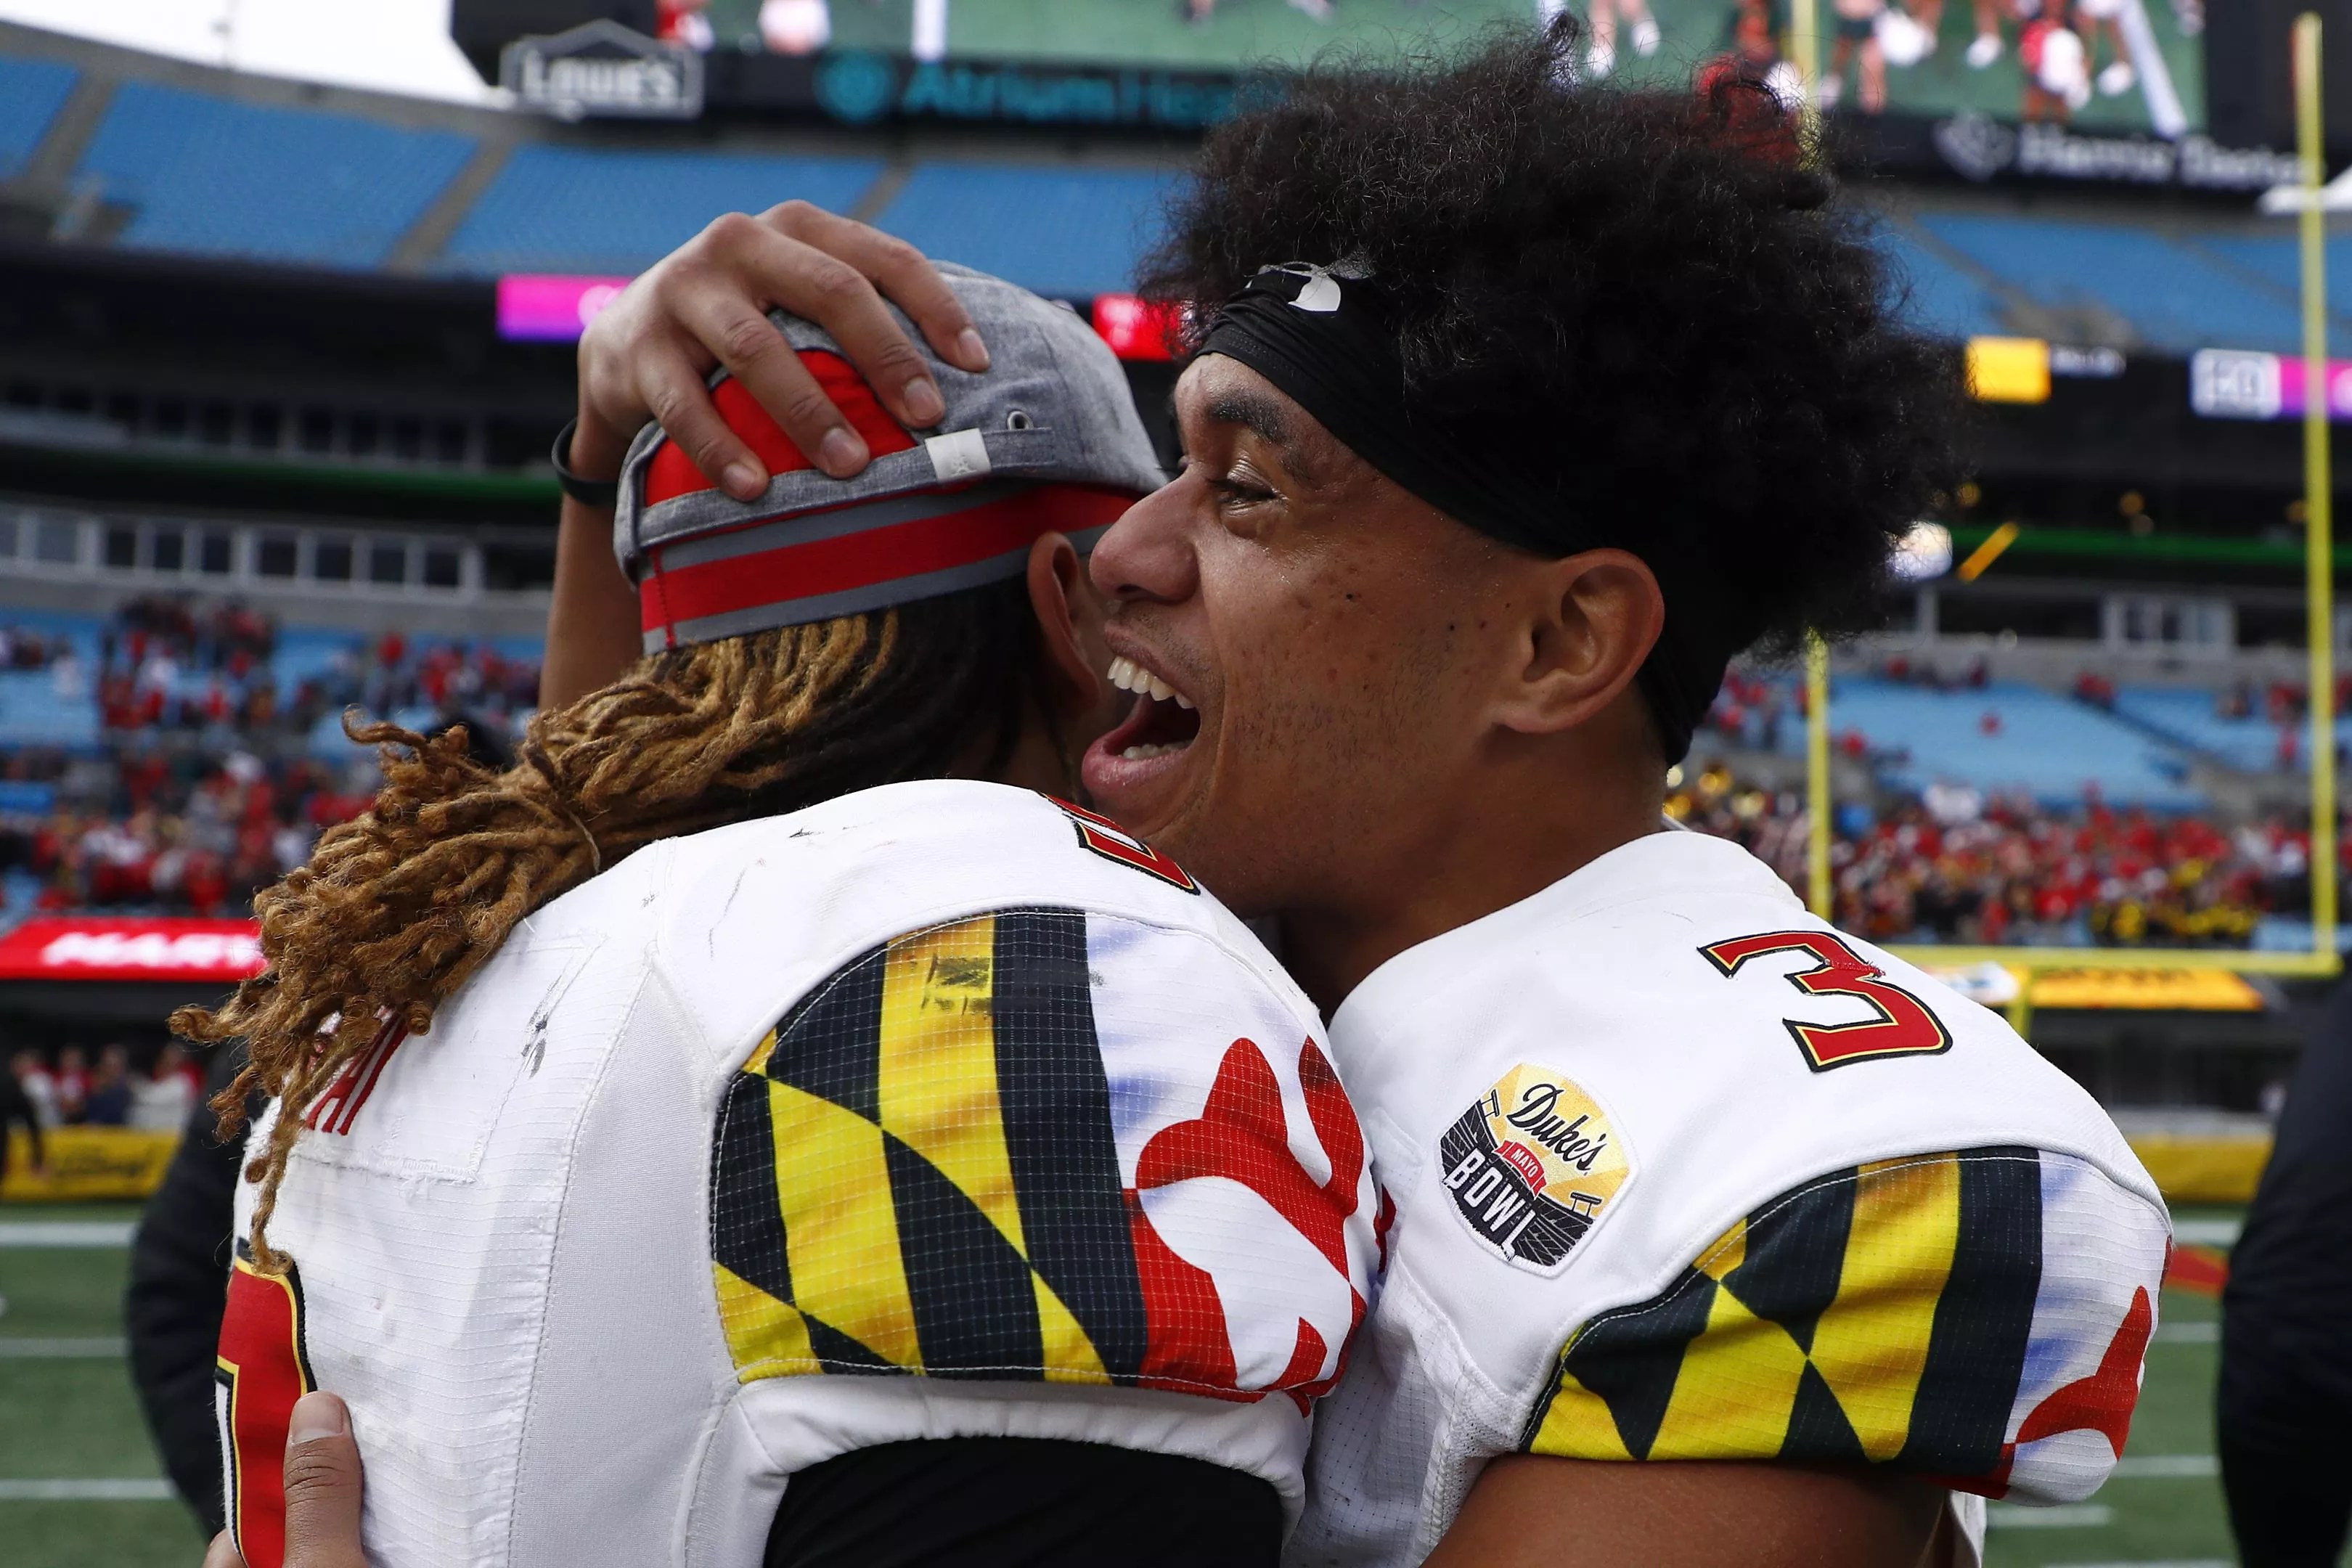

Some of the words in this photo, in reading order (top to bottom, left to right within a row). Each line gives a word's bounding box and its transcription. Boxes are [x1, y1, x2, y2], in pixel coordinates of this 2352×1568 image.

[1696, 930, 1953, 1073] 3
[1506, 1083, 1608, 1175] Duke's
[1511, 1148, 1538, 1178] MAYO
[1442, 1148, 1537, 1262] BOWL
